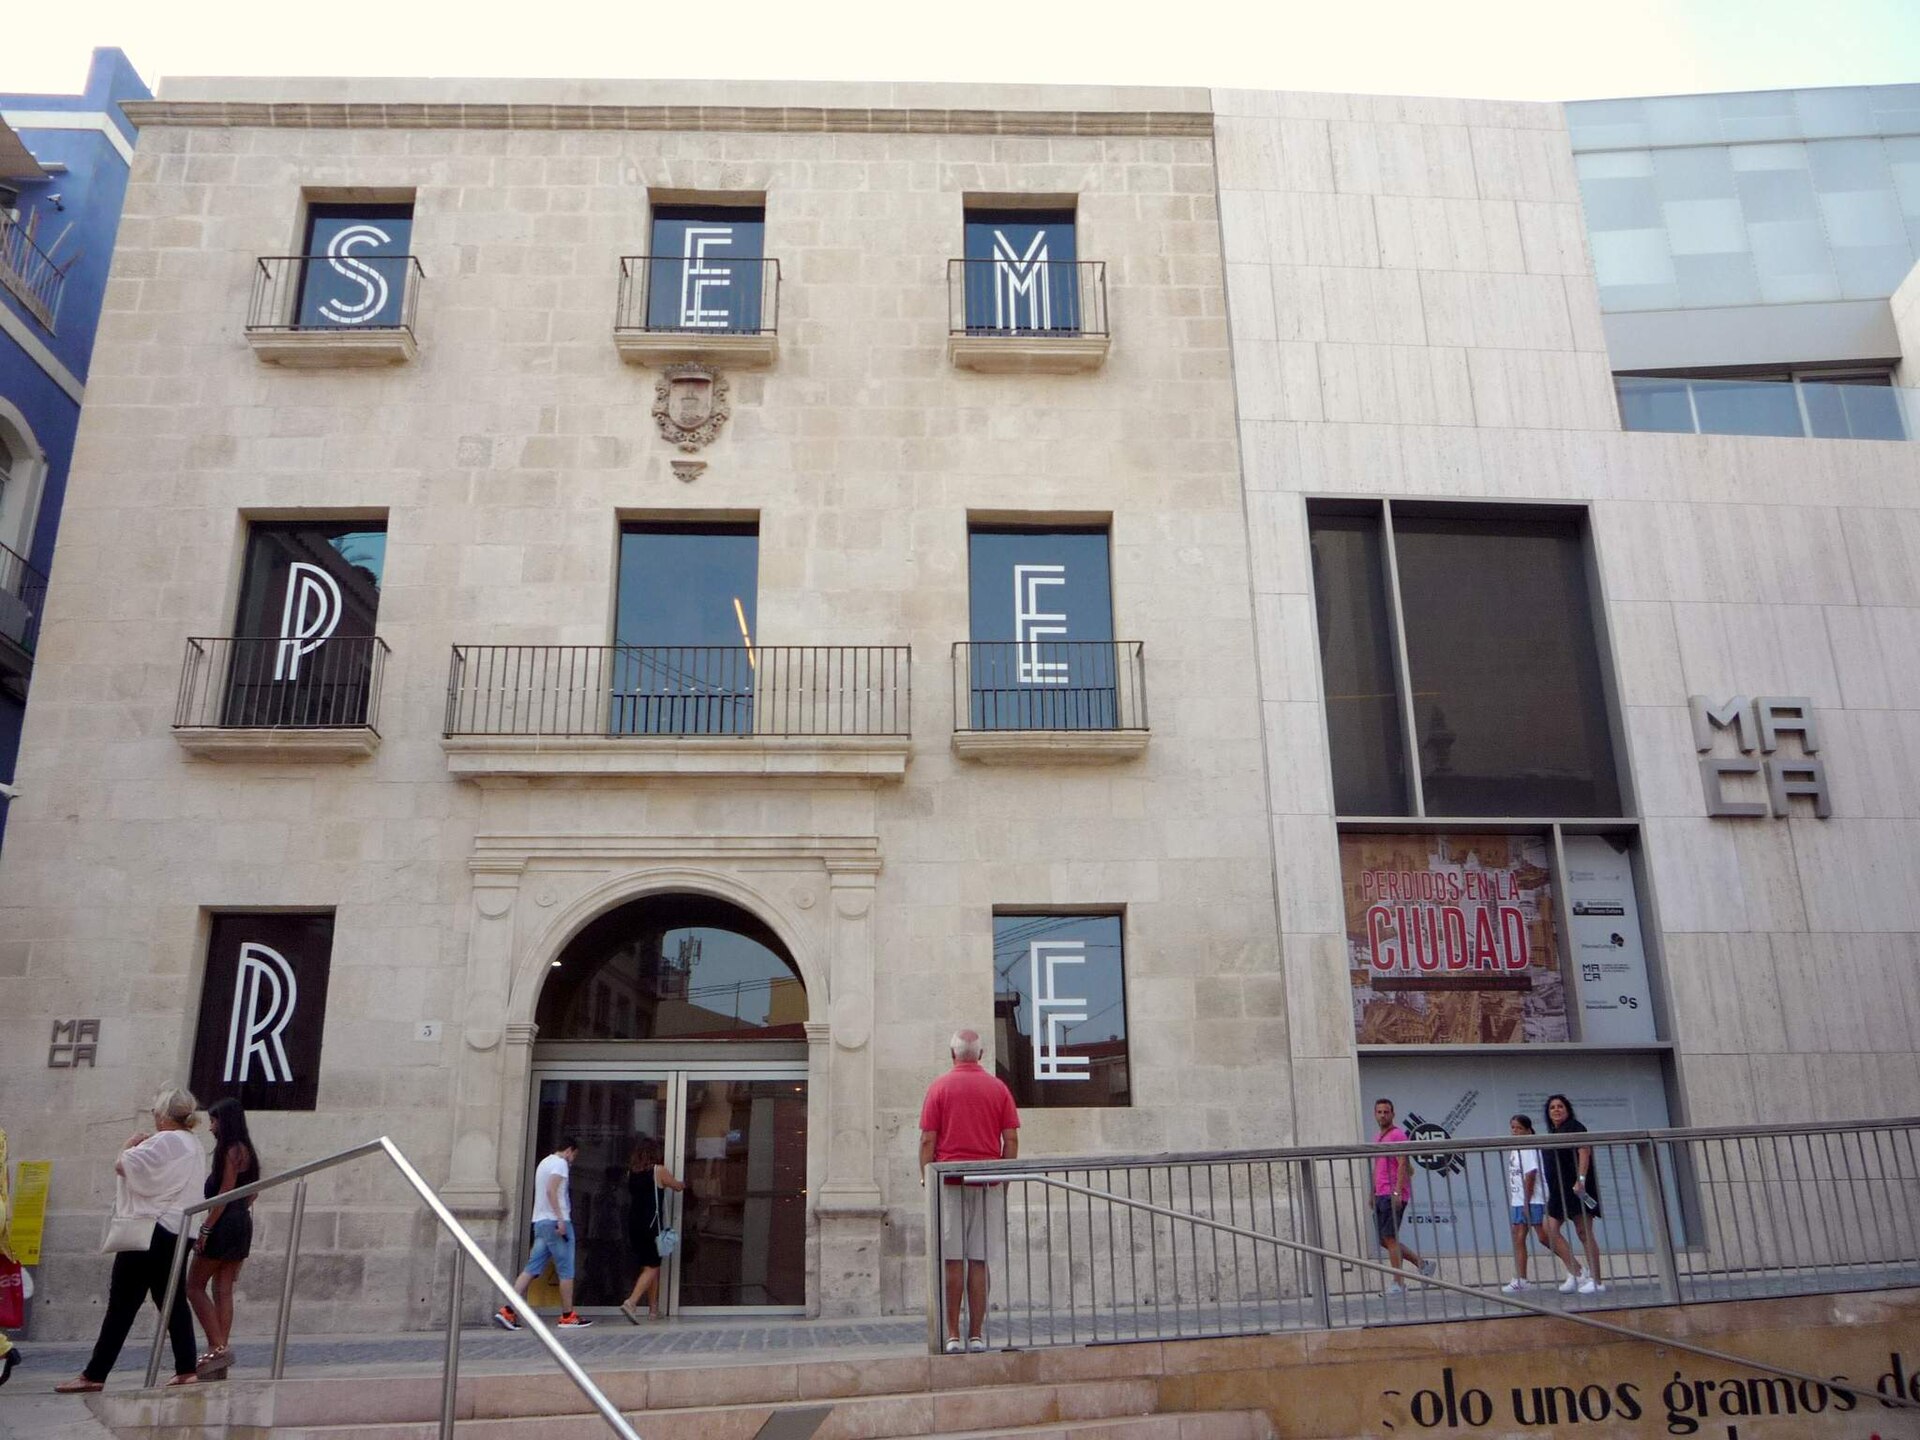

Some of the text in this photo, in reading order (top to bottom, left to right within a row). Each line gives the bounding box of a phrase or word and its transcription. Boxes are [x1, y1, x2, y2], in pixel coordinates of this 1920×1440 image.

[318, 225, 1051, 334] S E M
[273, 562, 1069, 683] P E
[1361, 871, 1521, 901] PERDIDOS EN LA
[1366, 905, 1530, 972] CIUDAD
[223, 942, 298, 1082] R
[1030, 941, 1091, 1080] E
[1511, 1382, 1642, 1427] unos
[1663, 1371, 1857, 1435] gramos
